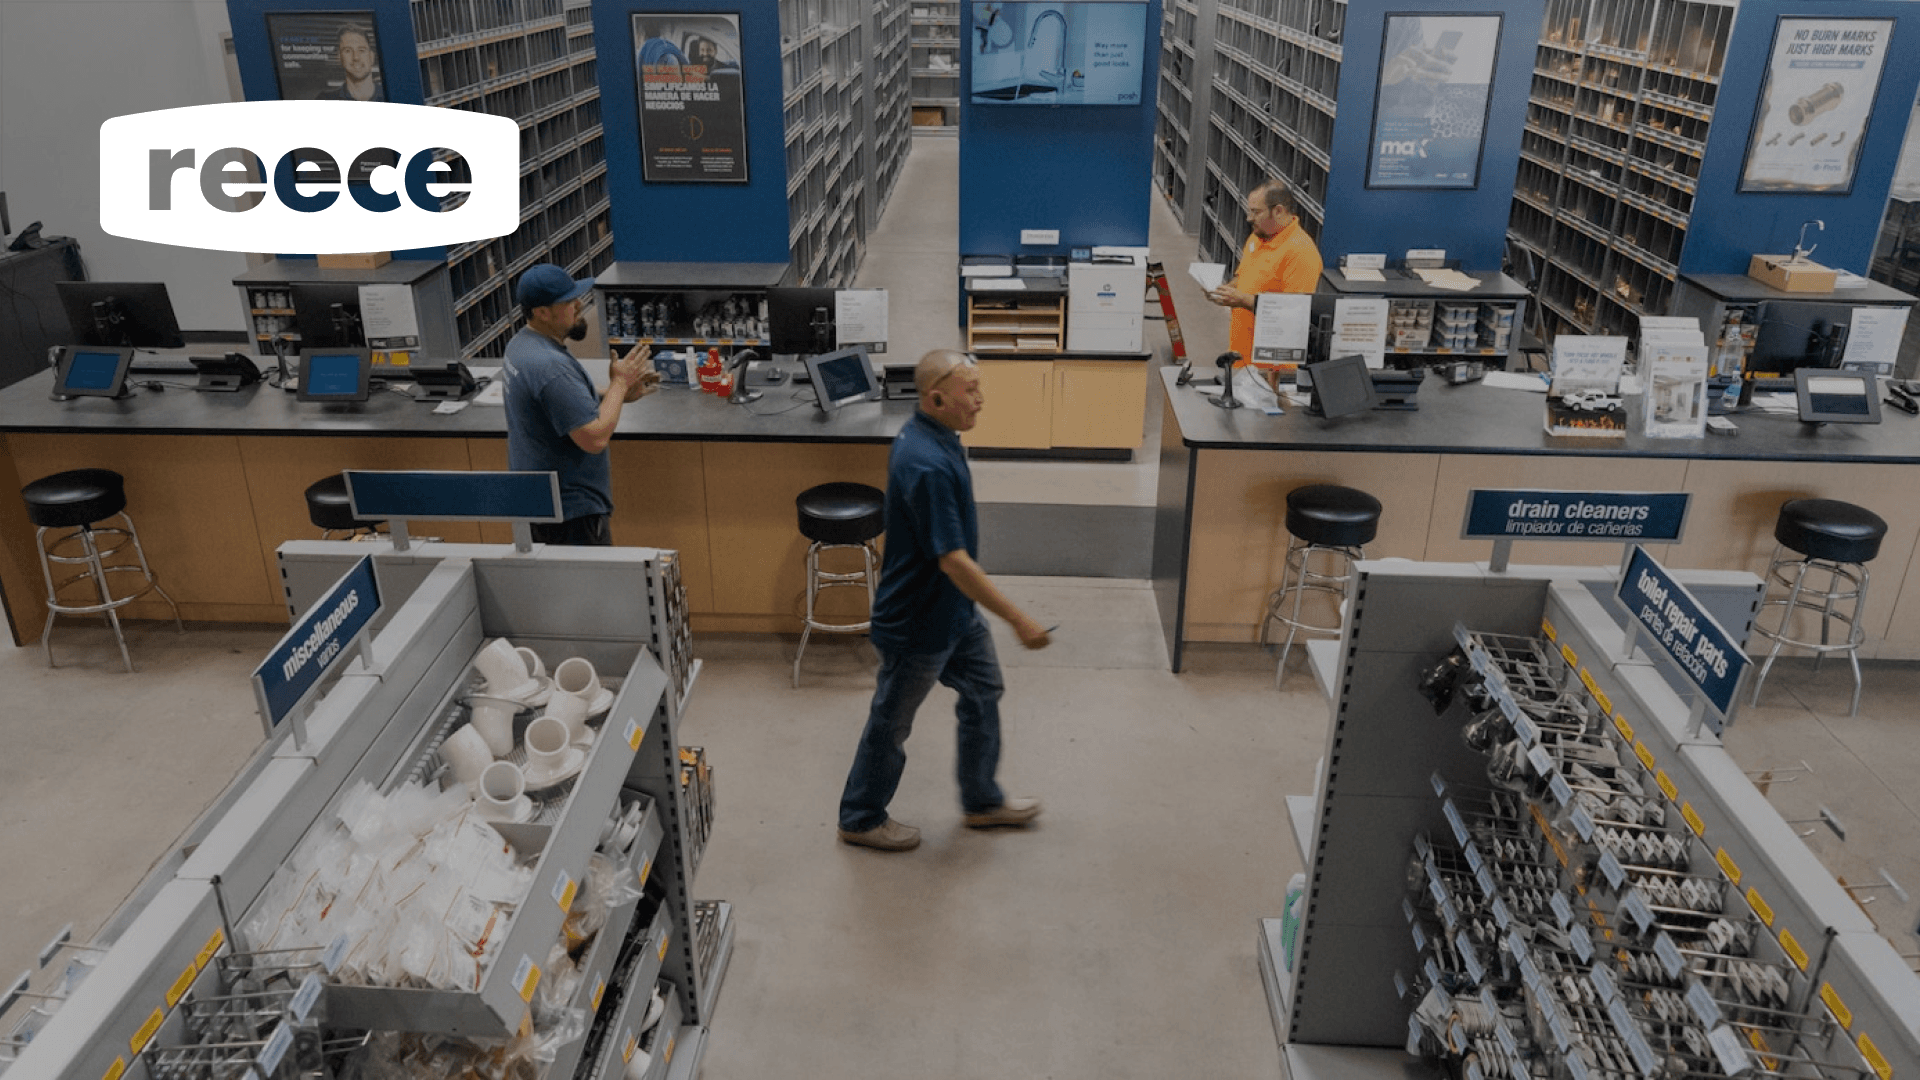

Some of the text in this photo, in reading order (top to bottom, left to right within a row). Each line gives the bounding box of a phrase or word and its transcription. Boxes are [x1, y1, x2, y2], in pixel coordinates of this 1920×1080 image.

[1794, 29, 1877, 42] NO BURN MARKS
[281, 44, 291, 52] for
[292, 44, 322, 54] keeping
[1786, 43, 1874, 56] JUST HIGH MARKS
[707, 83, 719, 91] LA
[644, 92, 721, 101] MANERA DE HACER
[1118, 91, 1138, 101] posh
[645, 101, 685, 110] NEGOCIOS
[1508, 500, 1650, 520] drain cleaners
[1505, 519, 1643, 536] limpiador de cañerías
[1638, 568, 1729, 679] toilet repair parts
[282, 589, 359, 682] miscellaneous
[1640, 604, 1708, 685] partes de refacción
[317, 637, 340, 669] varios
